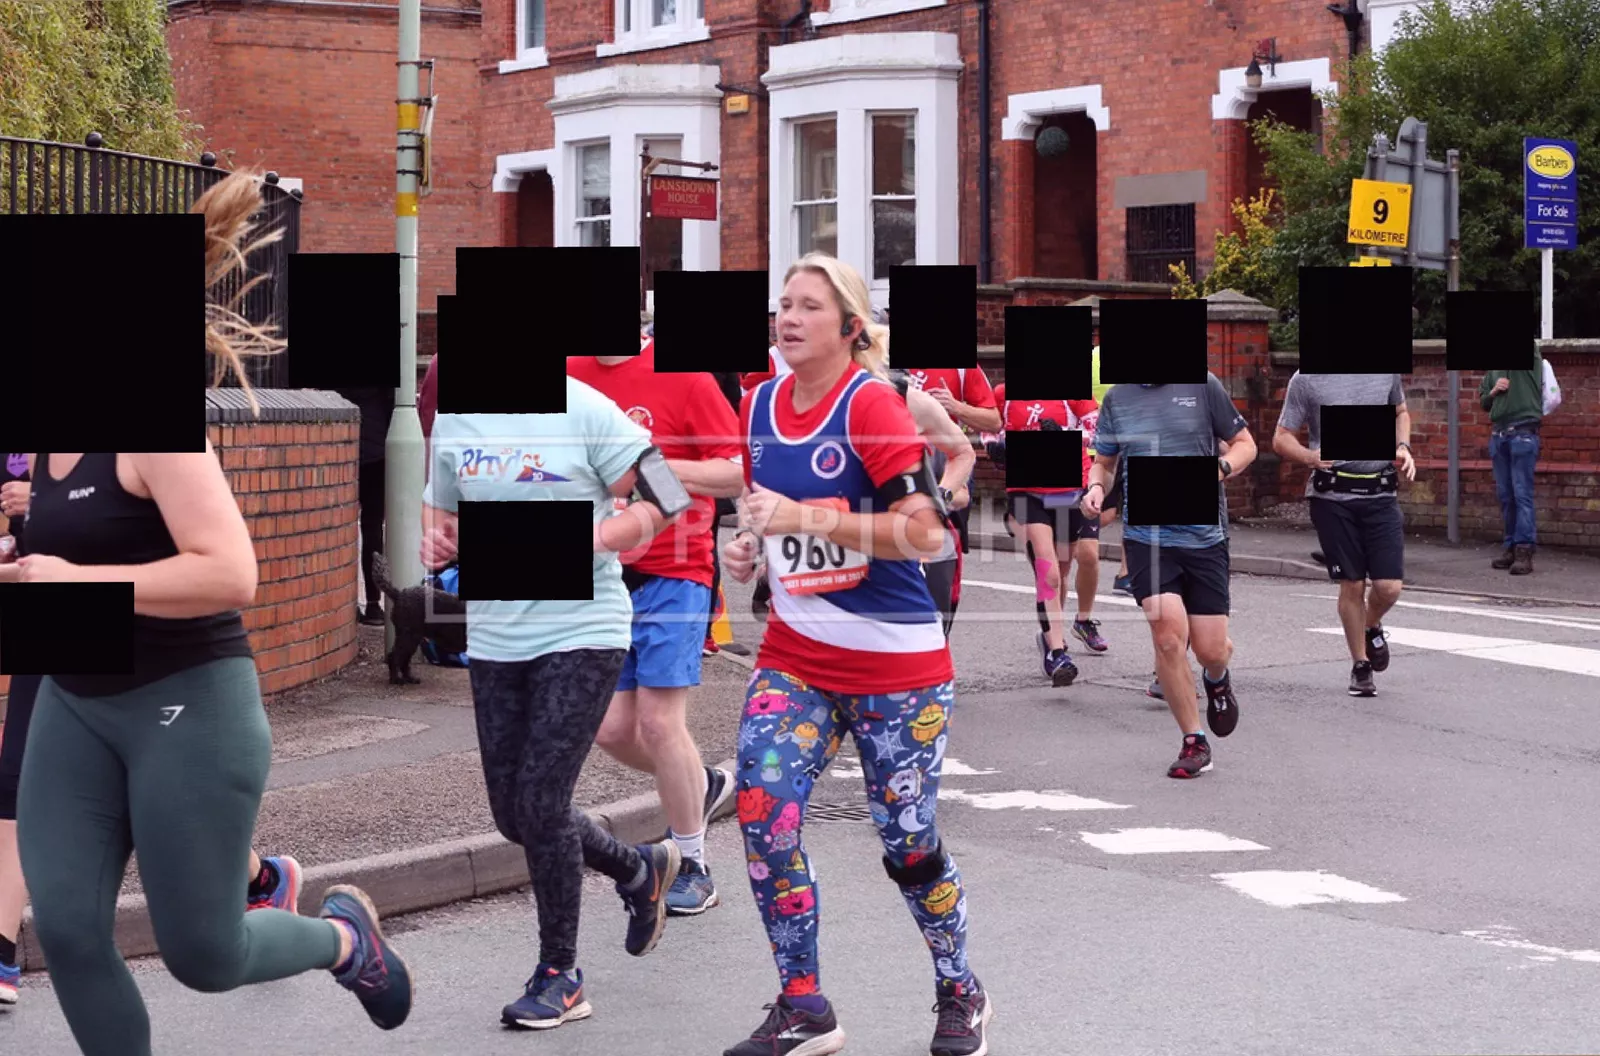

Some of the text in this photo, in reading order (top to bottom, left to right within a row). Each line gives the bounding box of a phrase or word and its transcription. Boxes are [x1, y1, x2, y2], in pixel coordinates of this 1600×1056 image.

[1535, 154, 1568, 169] Barbers
[653, 180, 714, 194] LANSDOWN
[668, 192, 700, 204] HOUSE
[1373, 199, 1389, 224] 9
[1538, 204, 1568, 218] For Sale
[1349, 229, 1405, 243] KILOMETRE
[782, 535, 845, 573] 960
